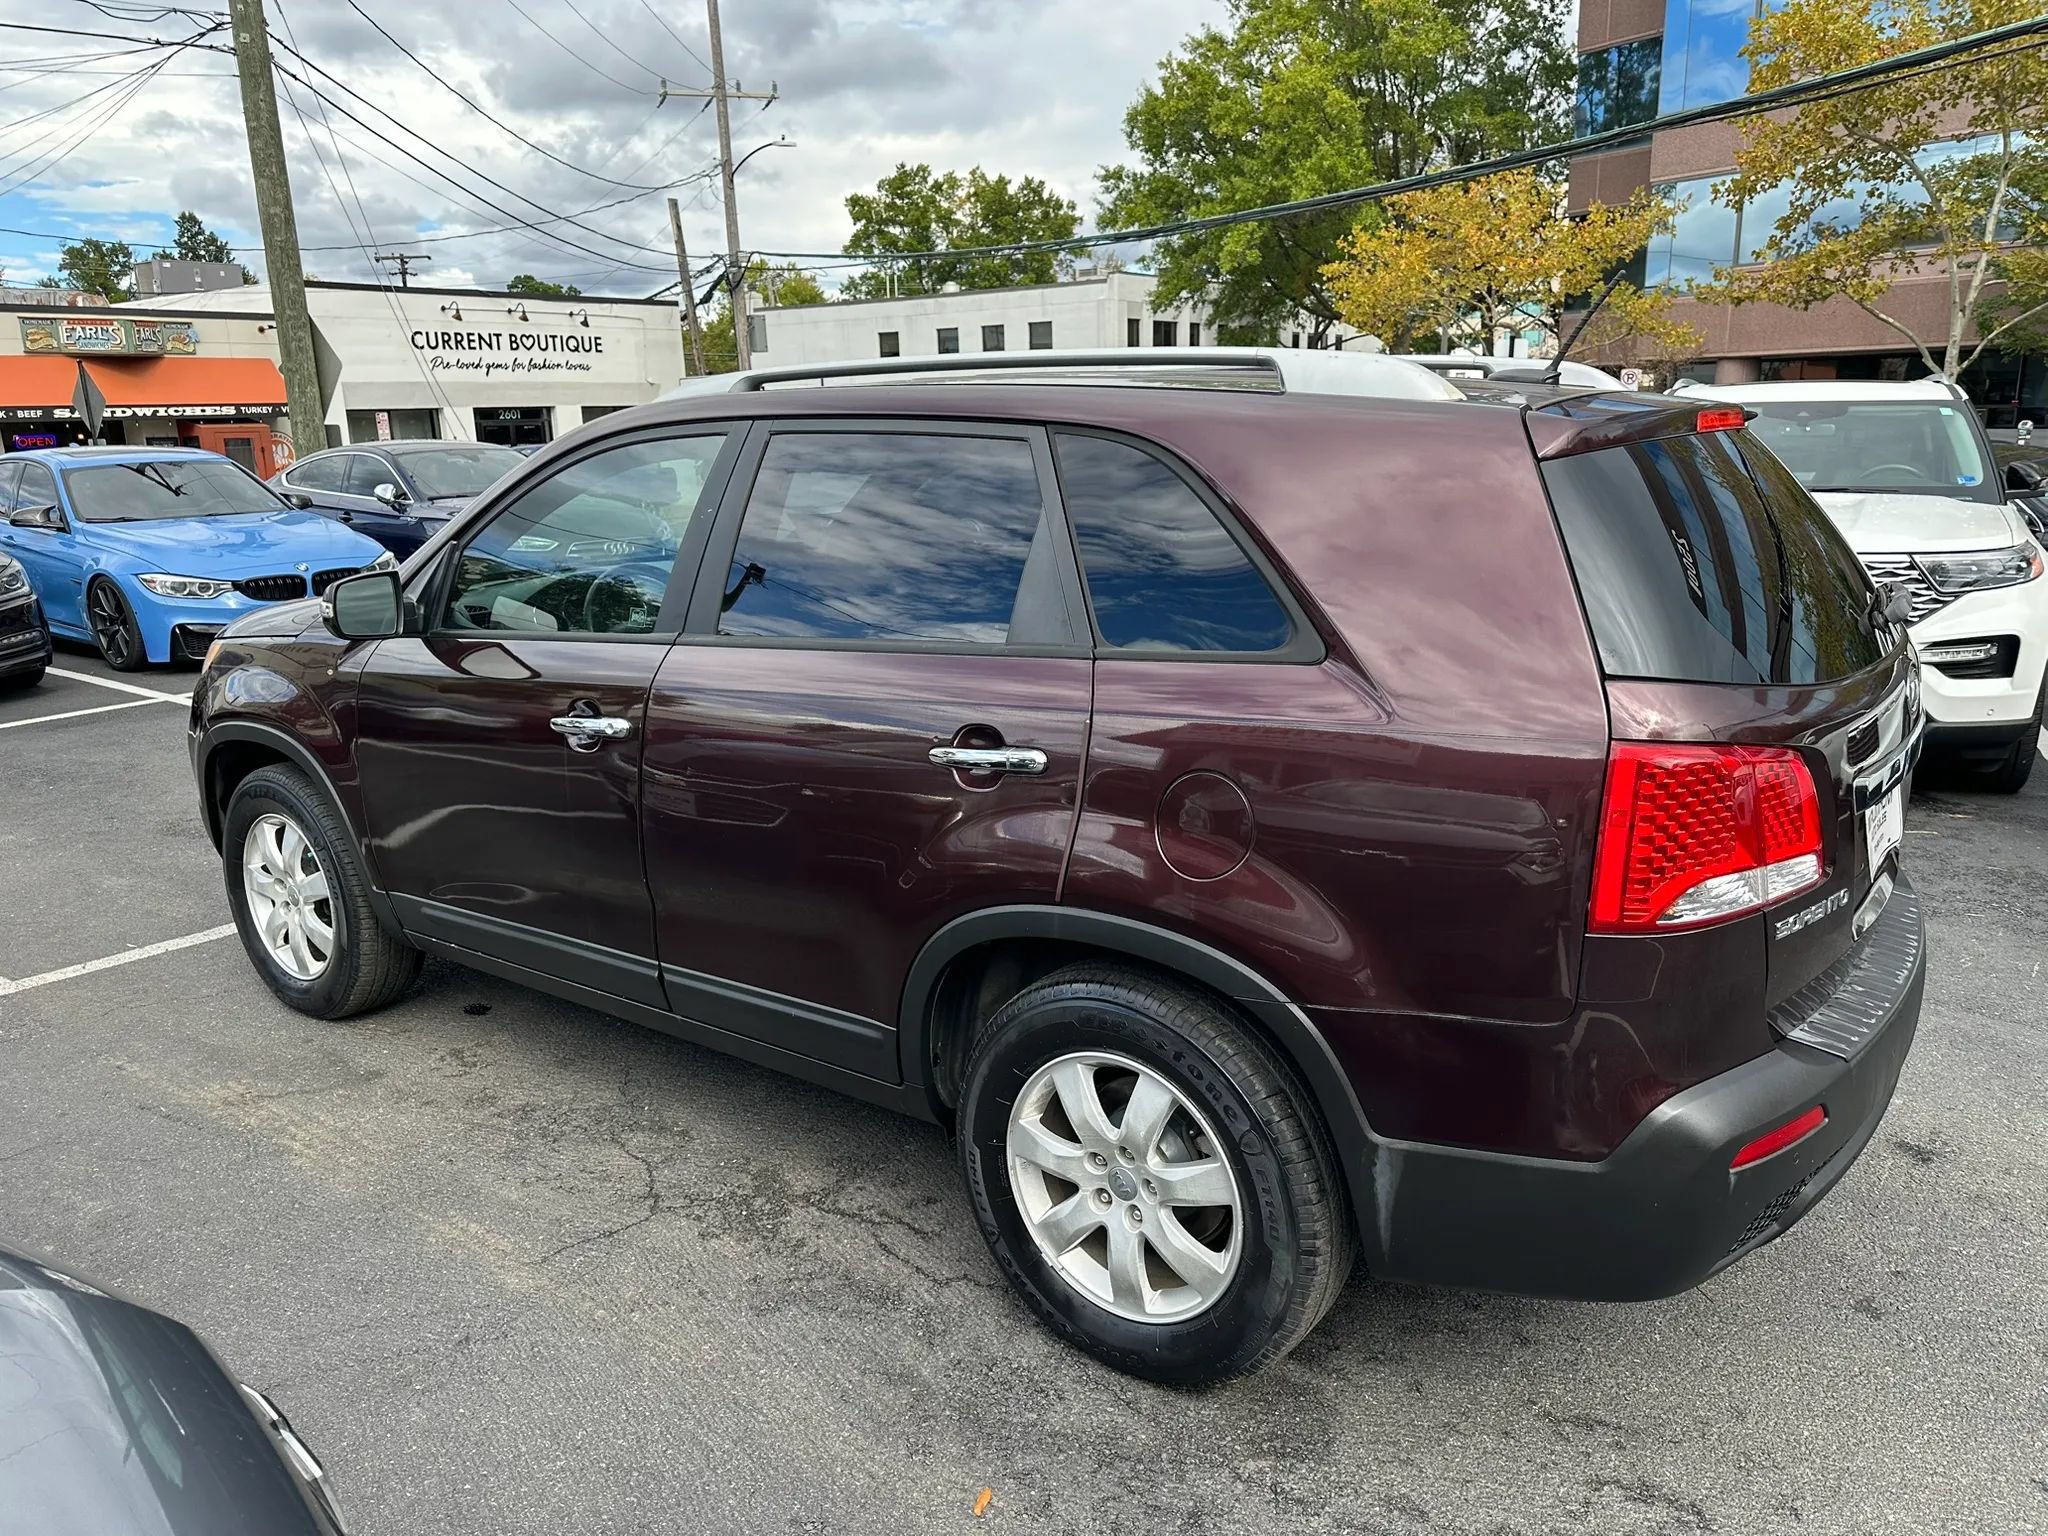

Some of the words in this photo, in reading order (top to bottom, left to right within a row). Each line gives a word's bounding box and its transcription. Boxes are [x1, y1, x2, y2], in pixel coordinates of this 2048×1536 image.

[62, 326, 121, 345] EARL'S
[134, 328, 162, 345] EARL'S
[411, 331, 502, 351] CURRENT
[430, 356, 483, 371] Pre-loved
[485, 361, 510, 376] gems
[511, 357, 526, 372] for
[527, 358, 563, 372] fashion
[565, 360, 592, 371] lovers
[17, 410, 42, 418] BEEF
[240, 406, 272, 414] TURKEY
[498, 409, 521, 419] 2601
[18, 437, 54, 447] OPEN
[1775, 888, 1849, 940] SORENTO
